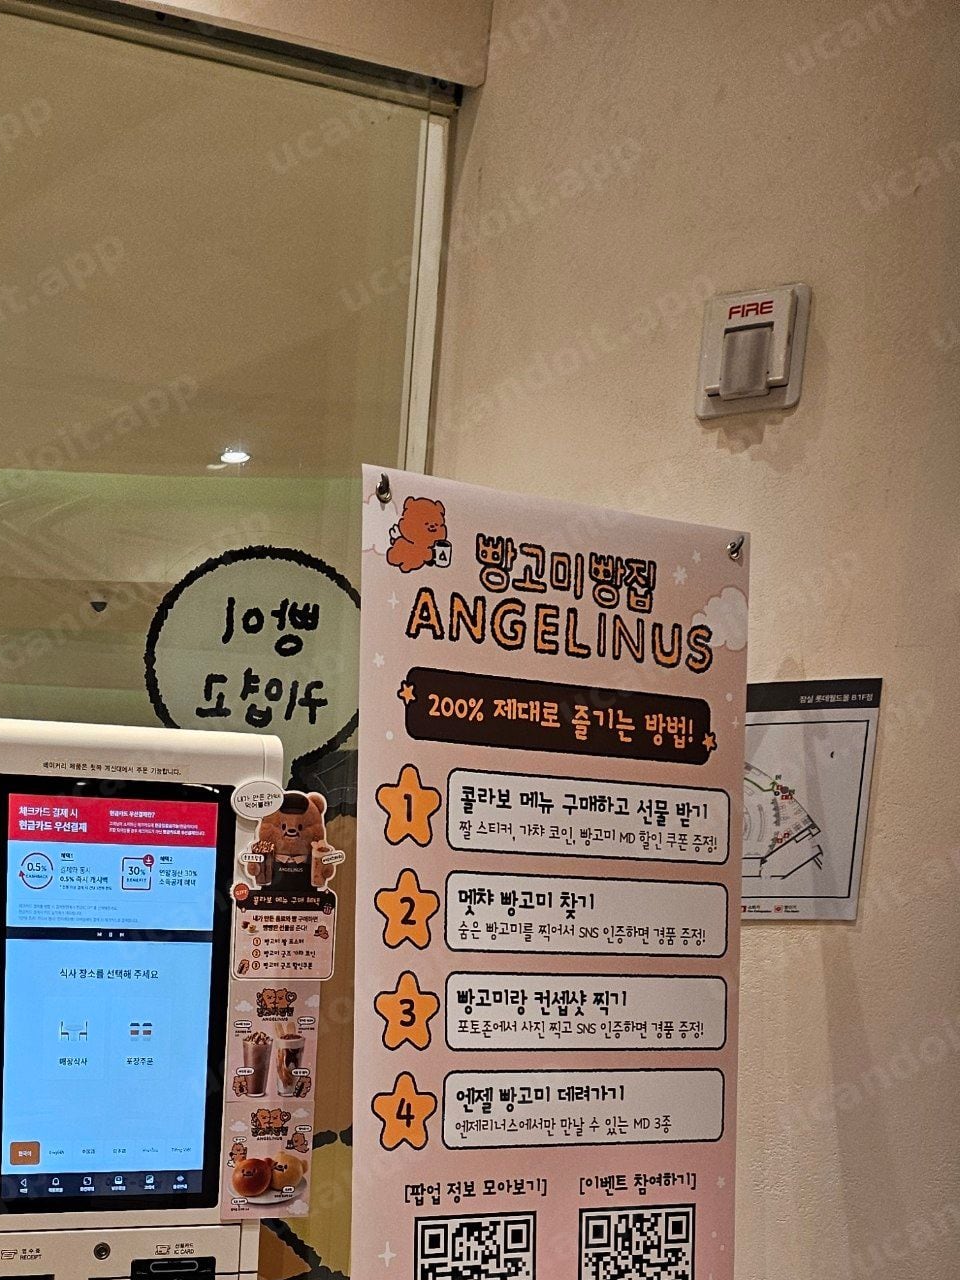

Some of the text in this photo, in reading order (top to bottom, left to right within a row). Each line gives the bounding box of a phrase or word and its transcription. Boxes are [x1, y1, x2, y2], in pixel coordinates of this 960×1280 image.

[728, 301, 773, 319] FIRE
[476, 533, 657, 614] 빵고미빵집
[405, 587, 713, 674] ANGELINUS
[428, 694, 694, 748] 200% 제대로 즐기는 방법!
[404, 794, 413, 822] 1
[460, 786, 708, 828] 콜라보 메뉴 구매하고 선물 받기
[458, 821, 472, 841] 짤
[476, 821, 516, 841] 스티커,
[580, 828, 616, 846] 빵고미
[619, 832, 635, 844] MD
[639, 830, 662, 850] 할인
[666, 833, 689, 851] 쿠폰
[692, 836, 717, 854] 증정!
[400, 897, 416, 925] 2
[501, 891, 553, 916] 빵고미
[560, 892, 595, 919] 찾기
[458, 922, 705, 945] 숨은 빵고미를 찍어서 SNS 인증하면 경품 증정!
[60, 968, 158, 979] 식사 장소를 선택해 주세요
[400, 999, 416, 1027] 3
[457, 989, 627, 1016] 빵고미랑 컨셉샷 찍기
[458, 1020, 704, 1039] 포토존에서 사진 찍고 SNS 인증하면 경품 증정!
[396, 1098, 415, 1128] 4
[456, 1085, 625, 1113] 엔젤 빵고미 데려가기
[456, 1115, 672, 1139] 엔제리너스에서만 만날 수 있는 MD 3종
[404, 1179, 547, 1206] [팝업 정보 모아보기]
[580, 1173, 696, 1197] [이벤트 참여하기]
